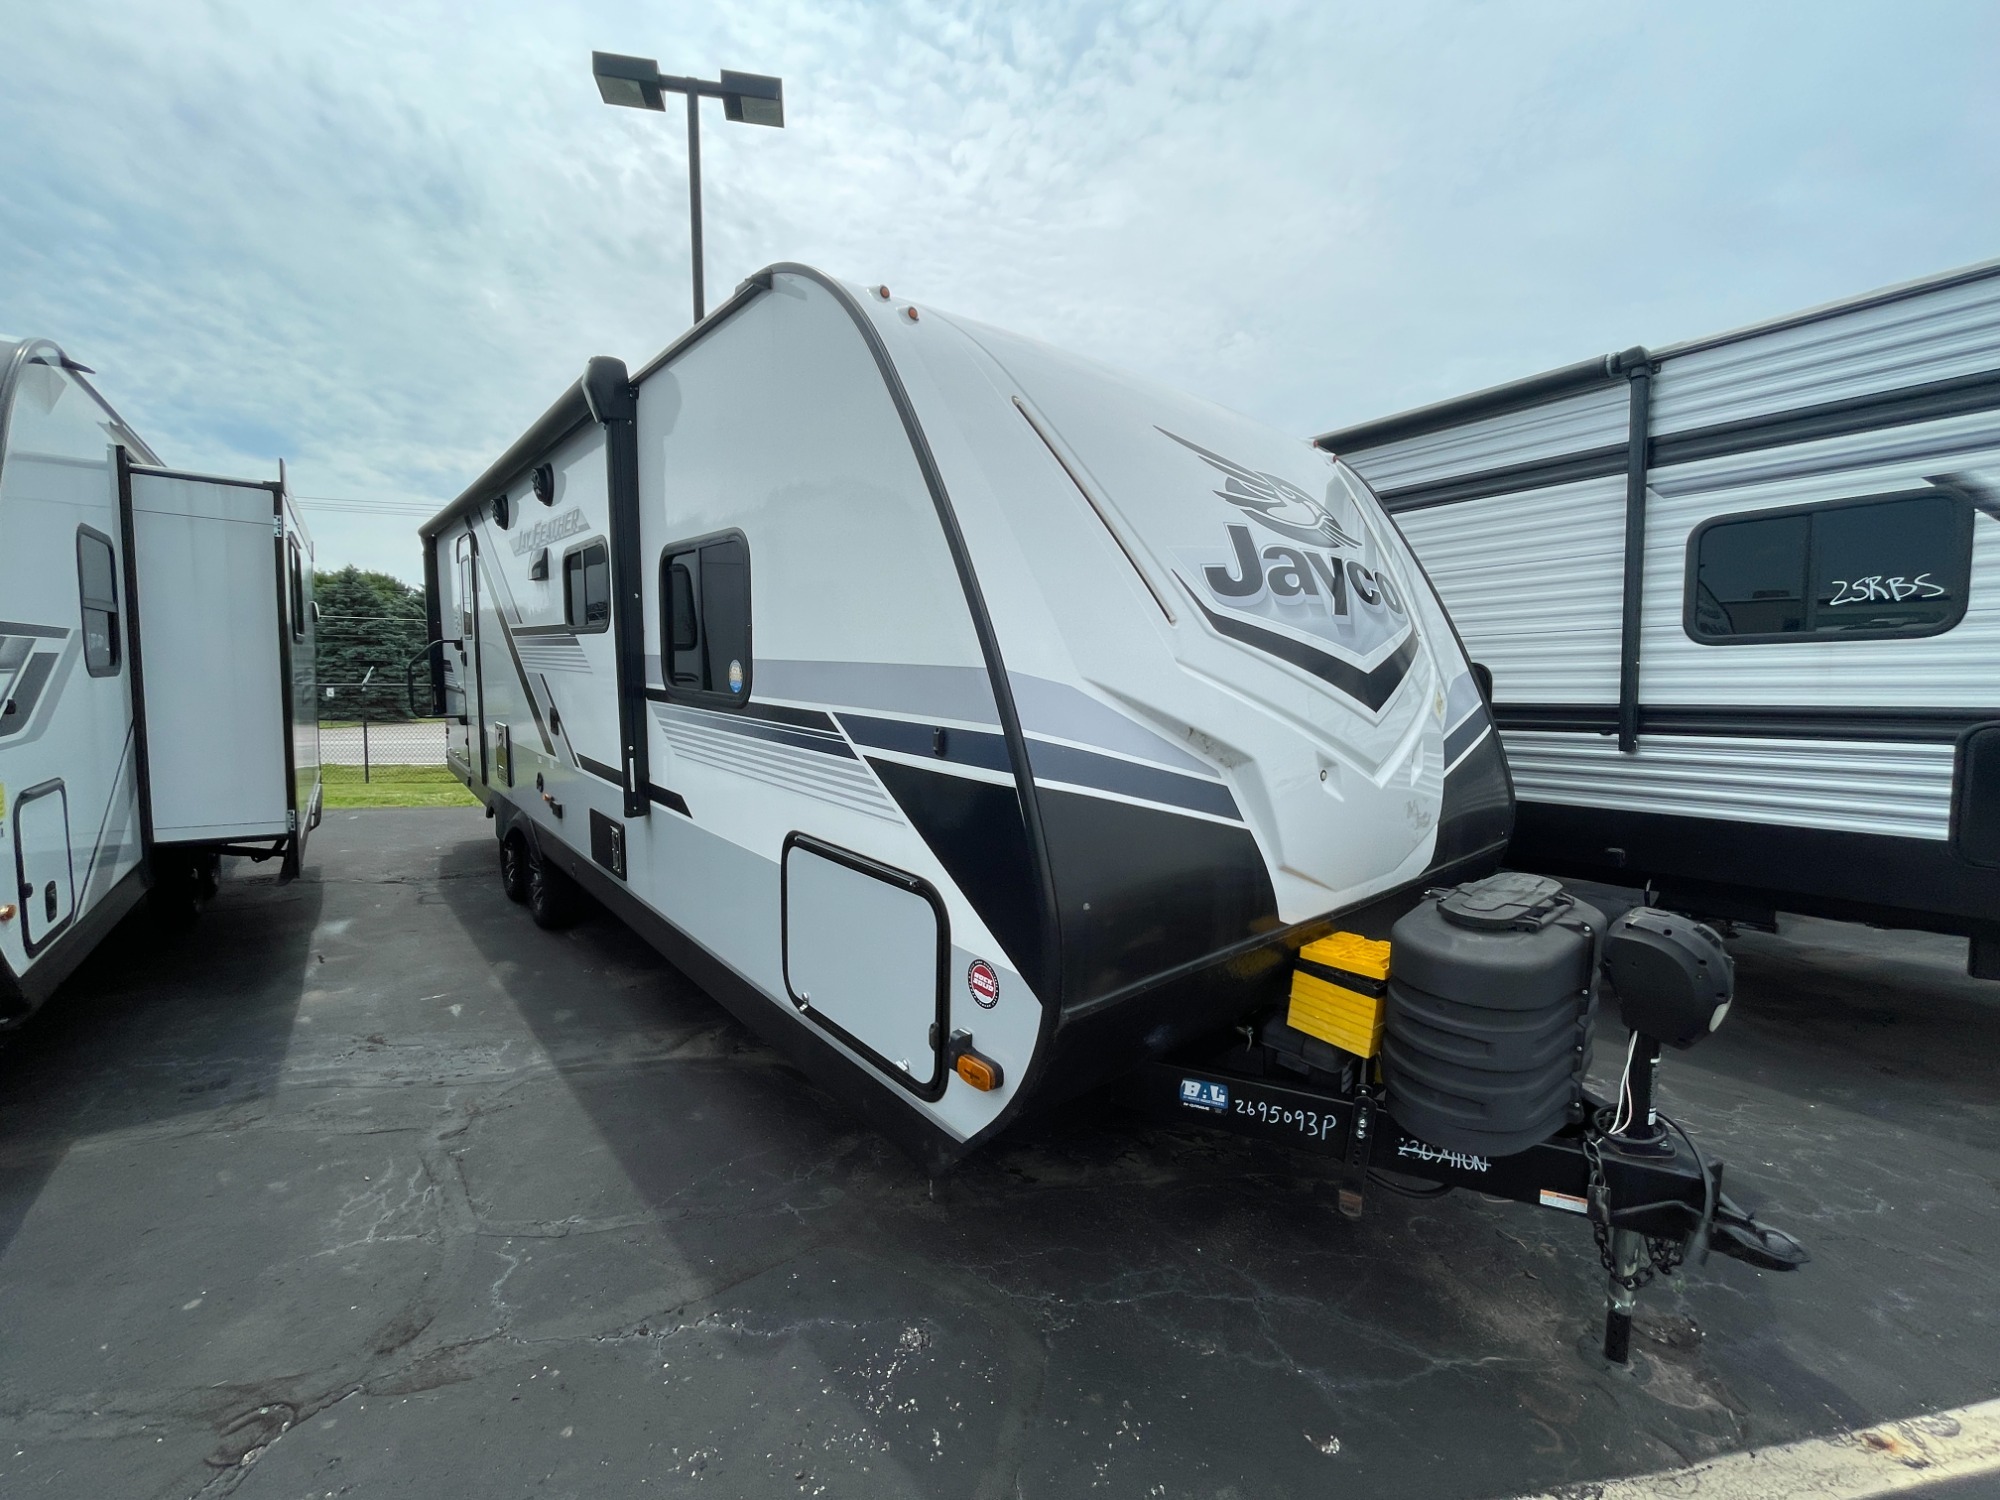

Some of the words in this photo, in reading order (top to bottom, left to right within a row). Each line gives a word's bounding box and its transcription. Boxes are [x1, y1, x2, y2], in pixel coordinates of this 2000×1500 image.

[532, 508, 581, 548] FEATHER
[1202, 522, 1405, 618] Jayco
[1829, 573, 1945, 605] 25RBS
[1234, 1099, 1337, 1141] 2695093P
